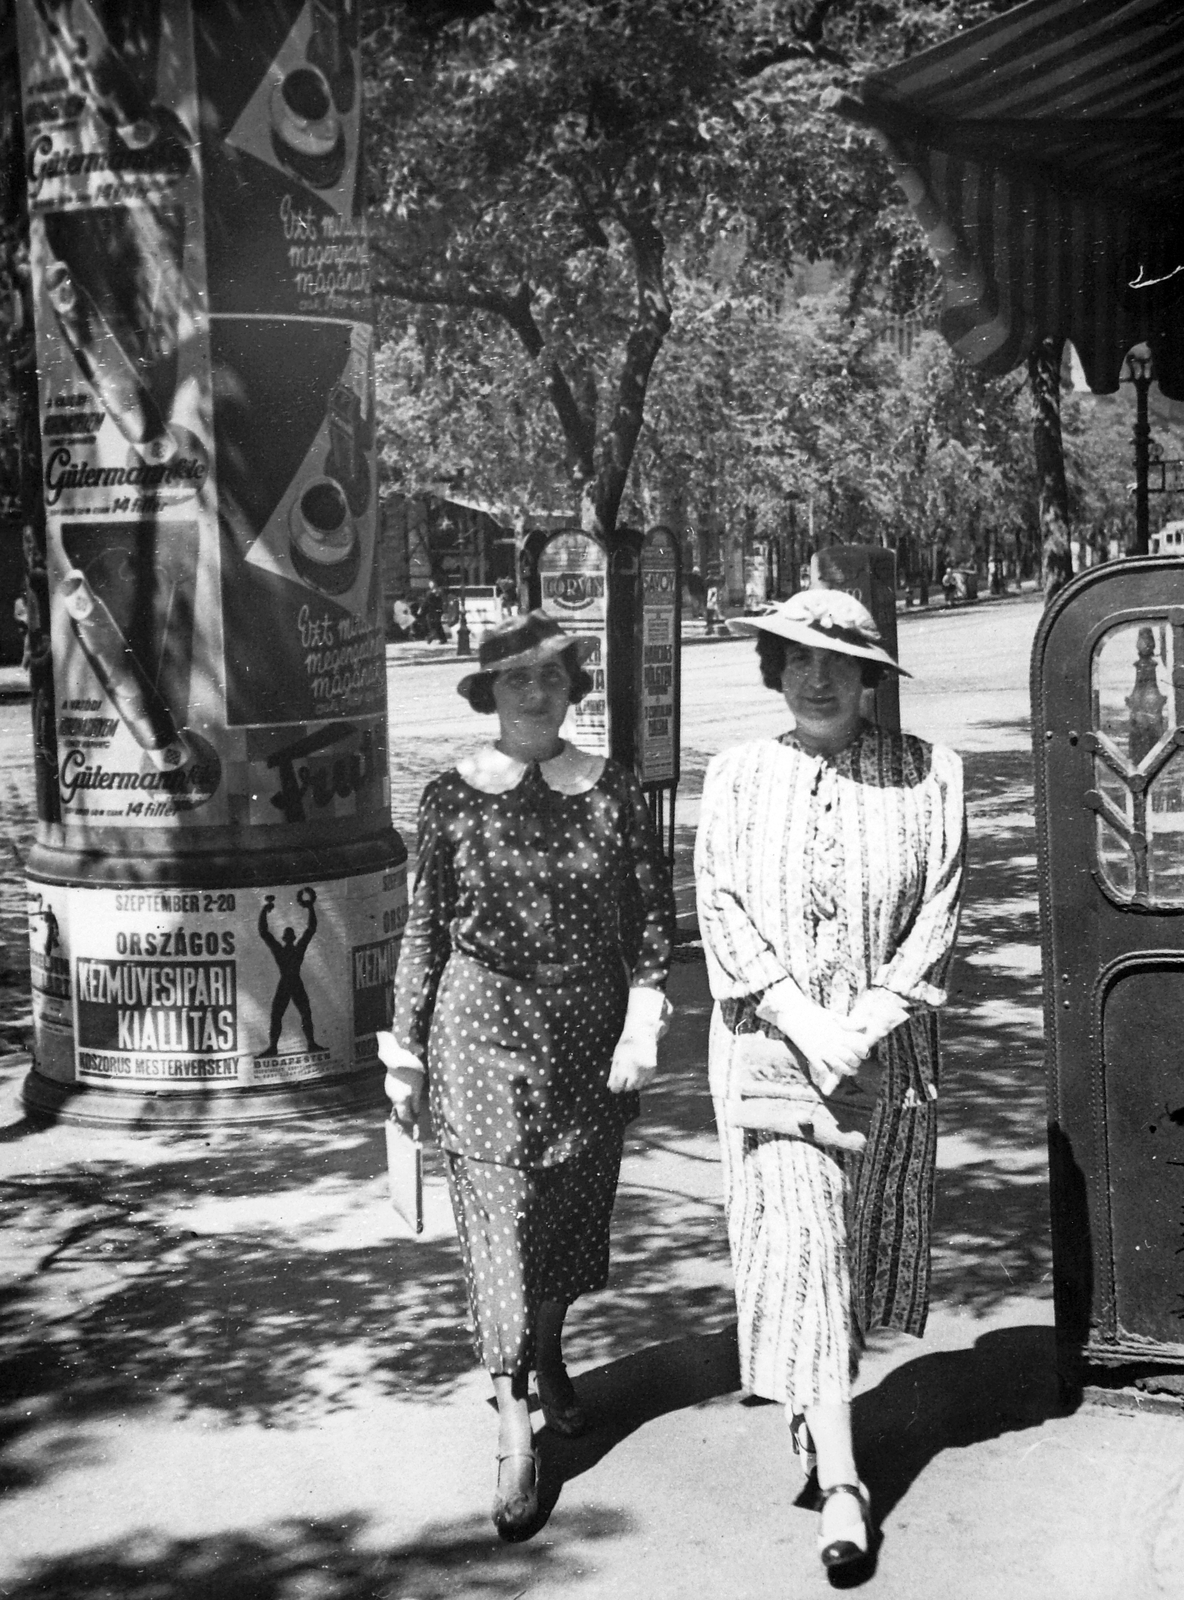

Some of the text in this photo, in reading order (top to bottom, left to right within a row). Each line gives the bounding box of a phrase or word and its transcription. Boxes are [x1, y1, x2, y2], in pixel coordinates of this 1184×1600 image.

[543, 577, 604, 597] CORVIN
[125, 802, 144, 817] 14
[116, 893, 236, 913] SZEPTEMBER 2-20
[116, 926, 236, 957] ORSZÁGOS
[117, 1007, 234, 1051] KIÁLLÍTÁS
[135, 1057, 240, 1076] MESTERVERSENY
